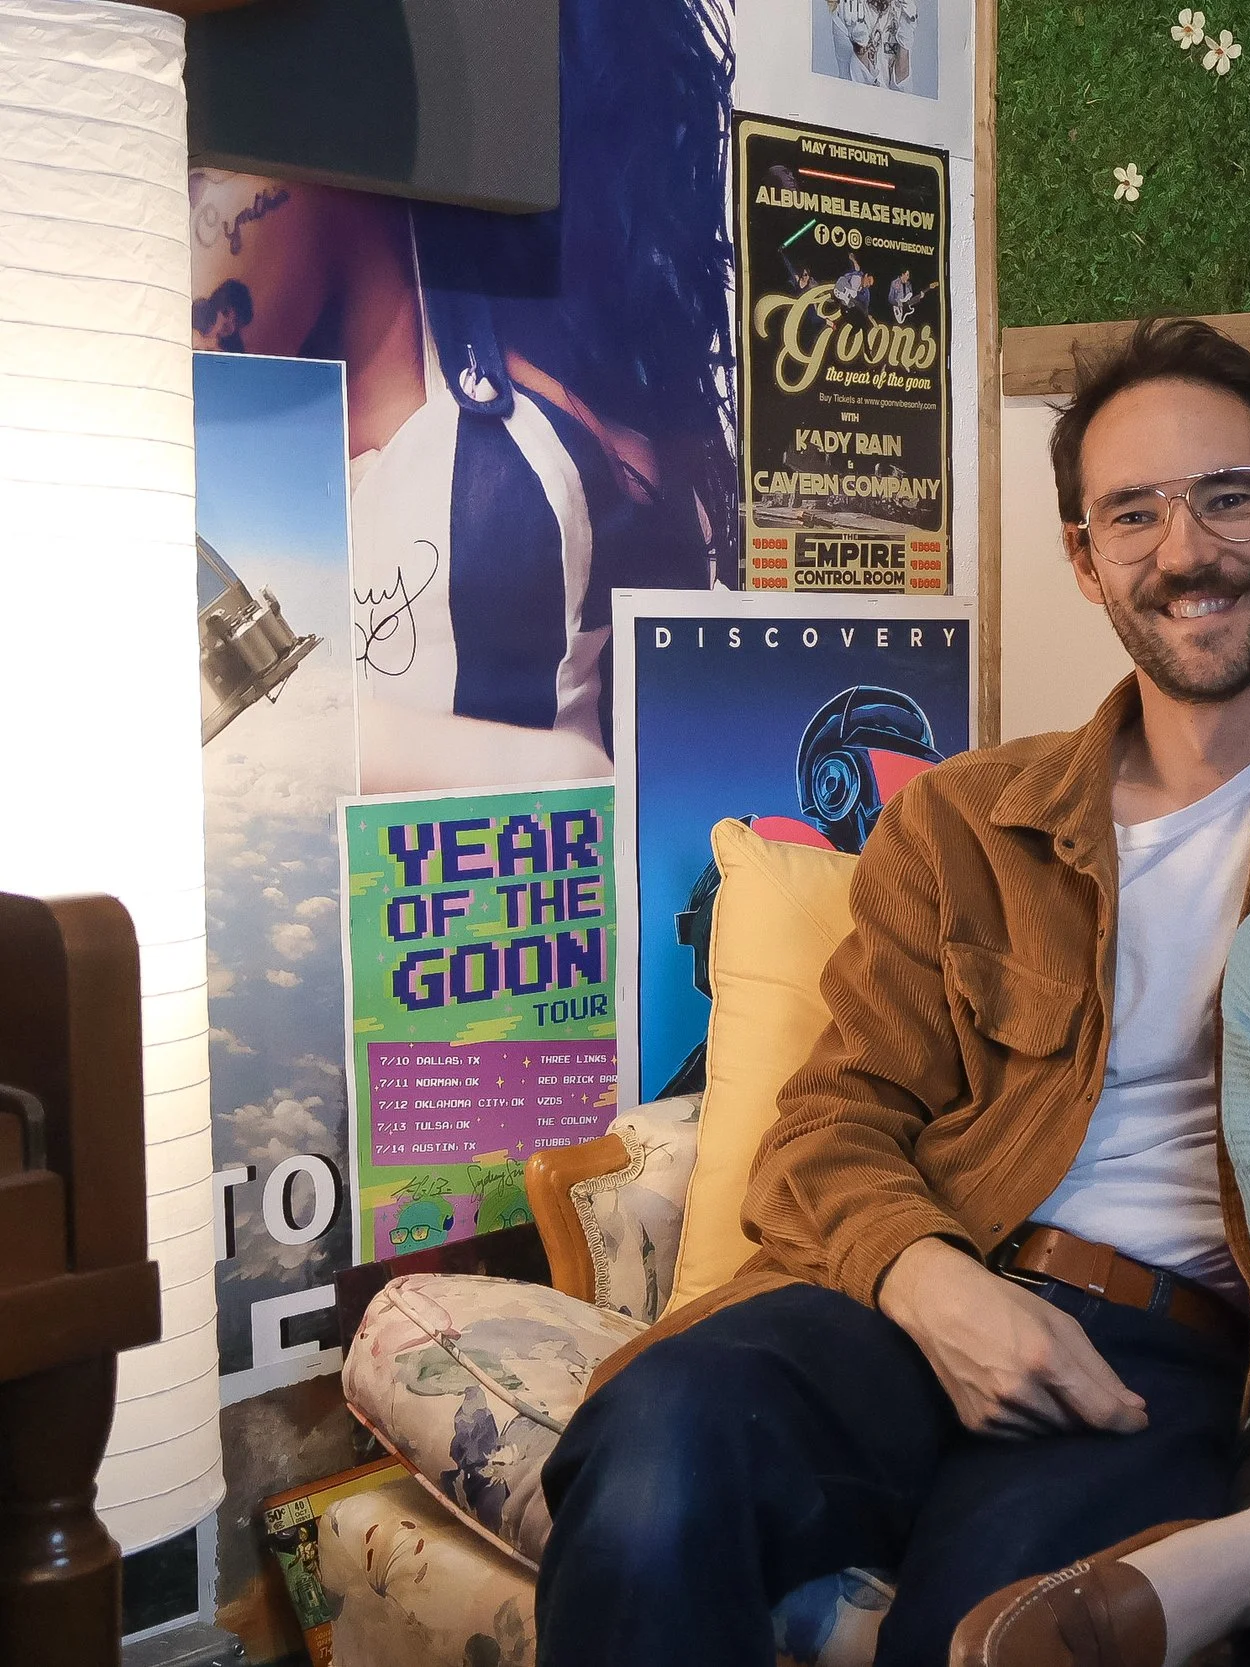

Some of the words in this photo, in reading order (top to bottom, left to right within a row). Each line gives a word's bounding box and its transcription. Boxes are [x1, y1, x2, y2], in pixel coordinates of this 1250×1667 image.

[802, 140, 826, 155] MAY
[828, 144, 848, 159] THE
[848, 147, 889, 167] FOURTH
[755, 186, 819, 212] ALBUM
[821, 196, 890, 223] RELEASE
[892, 207, 935, 230] SHOW
[864, 235, 935, 256] @GOONVIBESONLY
[754, 283, 937, 393] Goons
[825, 366, 844, 382] the
[844, 371, 871, 387] year
[872, 371, 887, 389] of
[887, 372, 904, 387] the
[905, 378, 932, 392] goon
[819, 392, 832, 403] Buy
[833, 394, 856, 404] Tickets
[856, 396, 863, 404] at
[864, 398, 937, 411] www.goonvibesonly.com
[841, 412, 860, 422] WITH
[795, 429, 852, 455] KADY
[855, 433, 902, 457] RAIN
[753, 471, 839, 496] CAVERN
[842, 475, 941, 500] COMPANY
[795, 533, 905, 568] EMPIRE
[795, 570, 861, 585] CONTROL
[864, 571, 905, 585] ROOM
[655, 627, 955, 648] DISCOVERY
[384, 809, 602, 887] YEAR
[386, 889, 475, 942] OF
[496, 874, 605, 929] THE
[388, 927, 607, 1012] GOON
[532, 993, 608, 1026] TOUR
[380, 1056, 410, 1066] 7/10
[416, 1056, 463, 1066] DALLAS,
[467, 1056, 481, 1065] TX
[540, 1055, 571, 1064] THREE
[576, 1054, 607, 1063] LINKS
[379, 1079, 409, 1088] 7/11
[415, 1078, 462, 1087] NORMAN,
[465, 1077, 480, 1087] OK
[538, 1076, 557, 1085] RED
[563, 1075, 594, 1084] BRICK
[599, 1074, 618, 1083] BAR
[378, 1100, 408, 1110] 7/12
[414, 1099, 472, 1109] OKLAHOMA
[477, 1098, 508, 1107] CITY,
[511, 1097, 525, 1107] OK
[377, 1122, 407, 1132] 7/13
[414, 1121, 453, 1131] TULSA,
[456, 1120, 471, 1130] OK
[537, 1117, 555, 1126] THE
[561, 1115, 598, 1125] COLONY
[376, 1144, 405, 1154] 7/14
[411, 1142, 459, 1153] AUSTIN,
[463, 1142, 477, 1151] TX
[534, 1138, 571, 1148] STUBBS
[294, 1501, 305, 1511] 40
[295, 1509, 307, 1518] OCT
